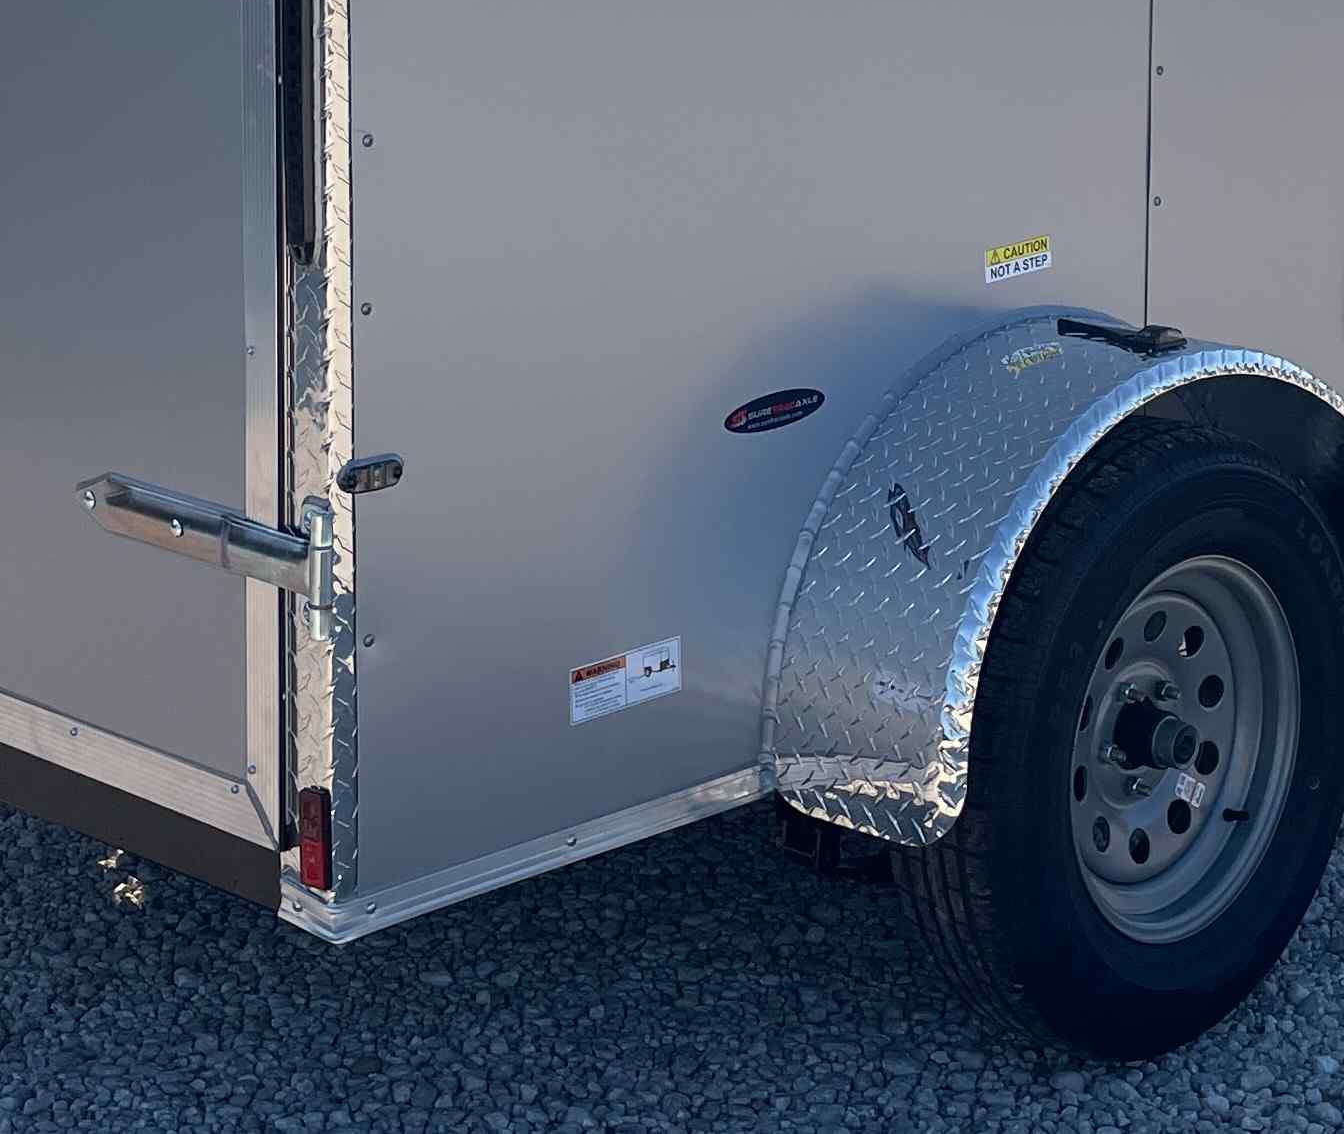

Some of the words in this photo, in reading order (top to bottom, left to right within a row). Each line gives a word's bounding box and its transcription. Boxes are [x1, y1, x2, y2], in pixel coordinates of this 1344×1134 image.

[1004, 238, 1048, 259] CAUTION
[991, 264, 1010, 279] NOT
[1013, 262, 1021, 274] A
[1023, 254, 1048, 271] STEP
